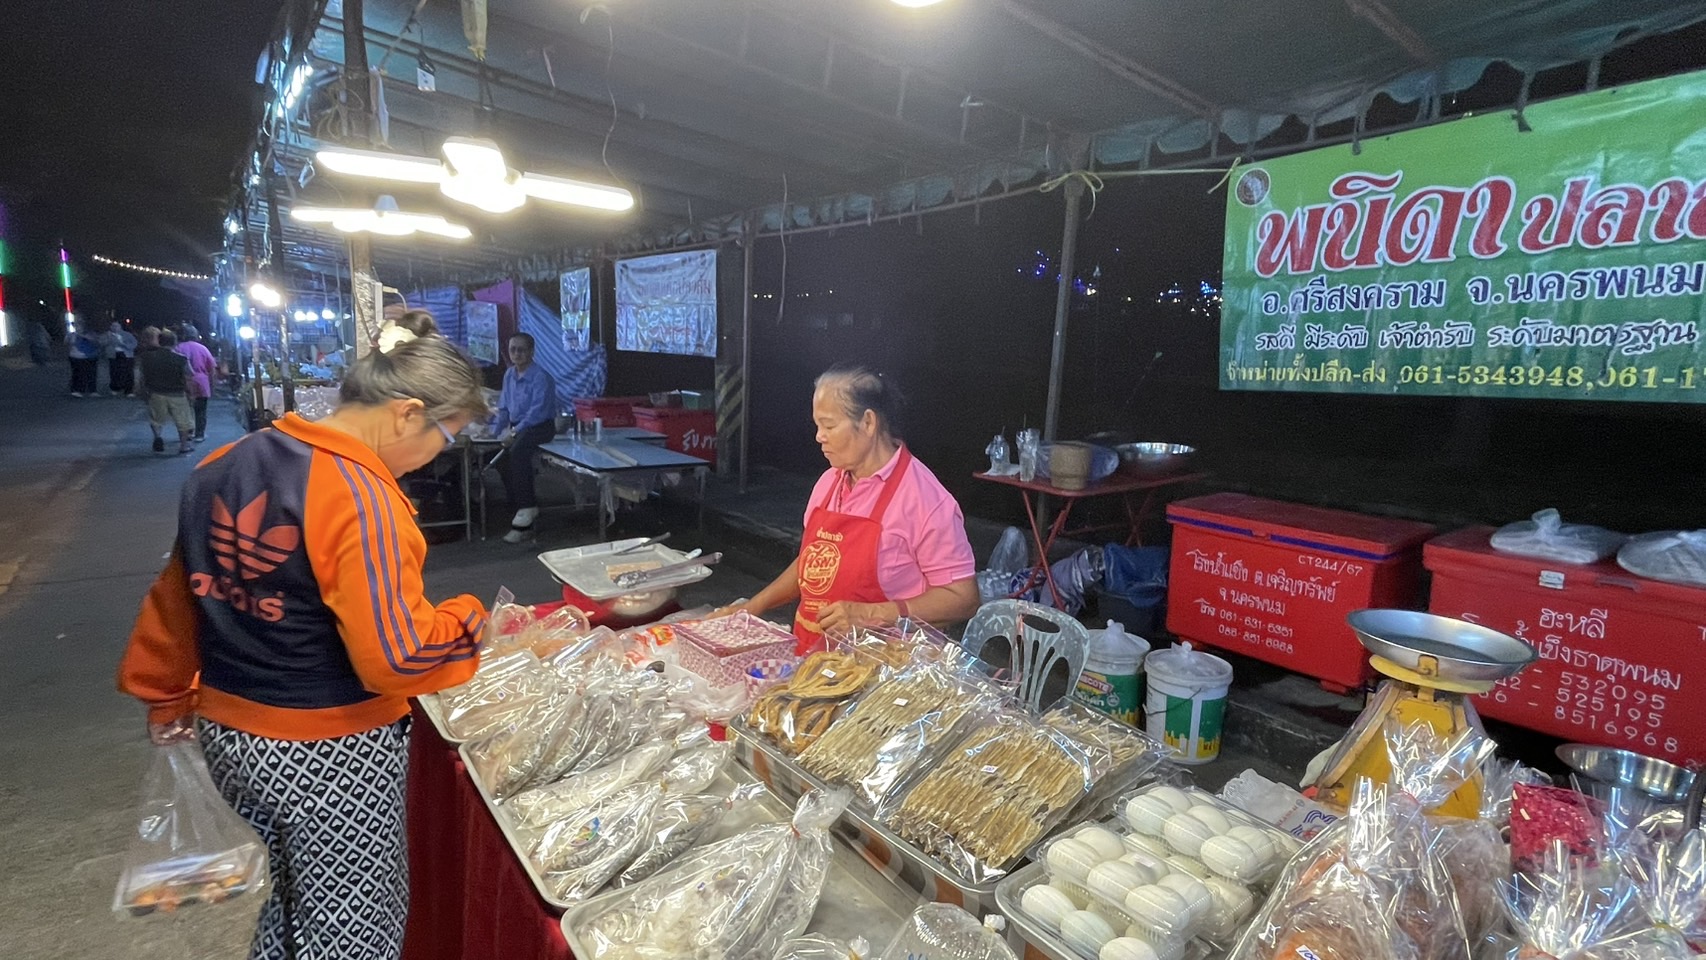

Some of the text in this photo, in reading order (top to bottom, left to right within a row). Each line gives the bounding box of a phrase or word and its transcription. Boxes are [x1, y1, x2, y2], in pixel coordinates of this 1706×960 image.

[1255, 170, 1706, 278] พนิดา ปลา
[1262, 262, 1705, 315] อ.ศรีสงคราม จ.นครพนม
[1255, 323, 1296, 350] รสดี
[1304, 322, 1369, 349] มีระดับ
[1378, 320, 1475, 349] เจ้าตำรับ
[1186, 549, 1249, 582] โรงน้ำแข็ง
[1298, 554, 1363, 576] CT244/67
